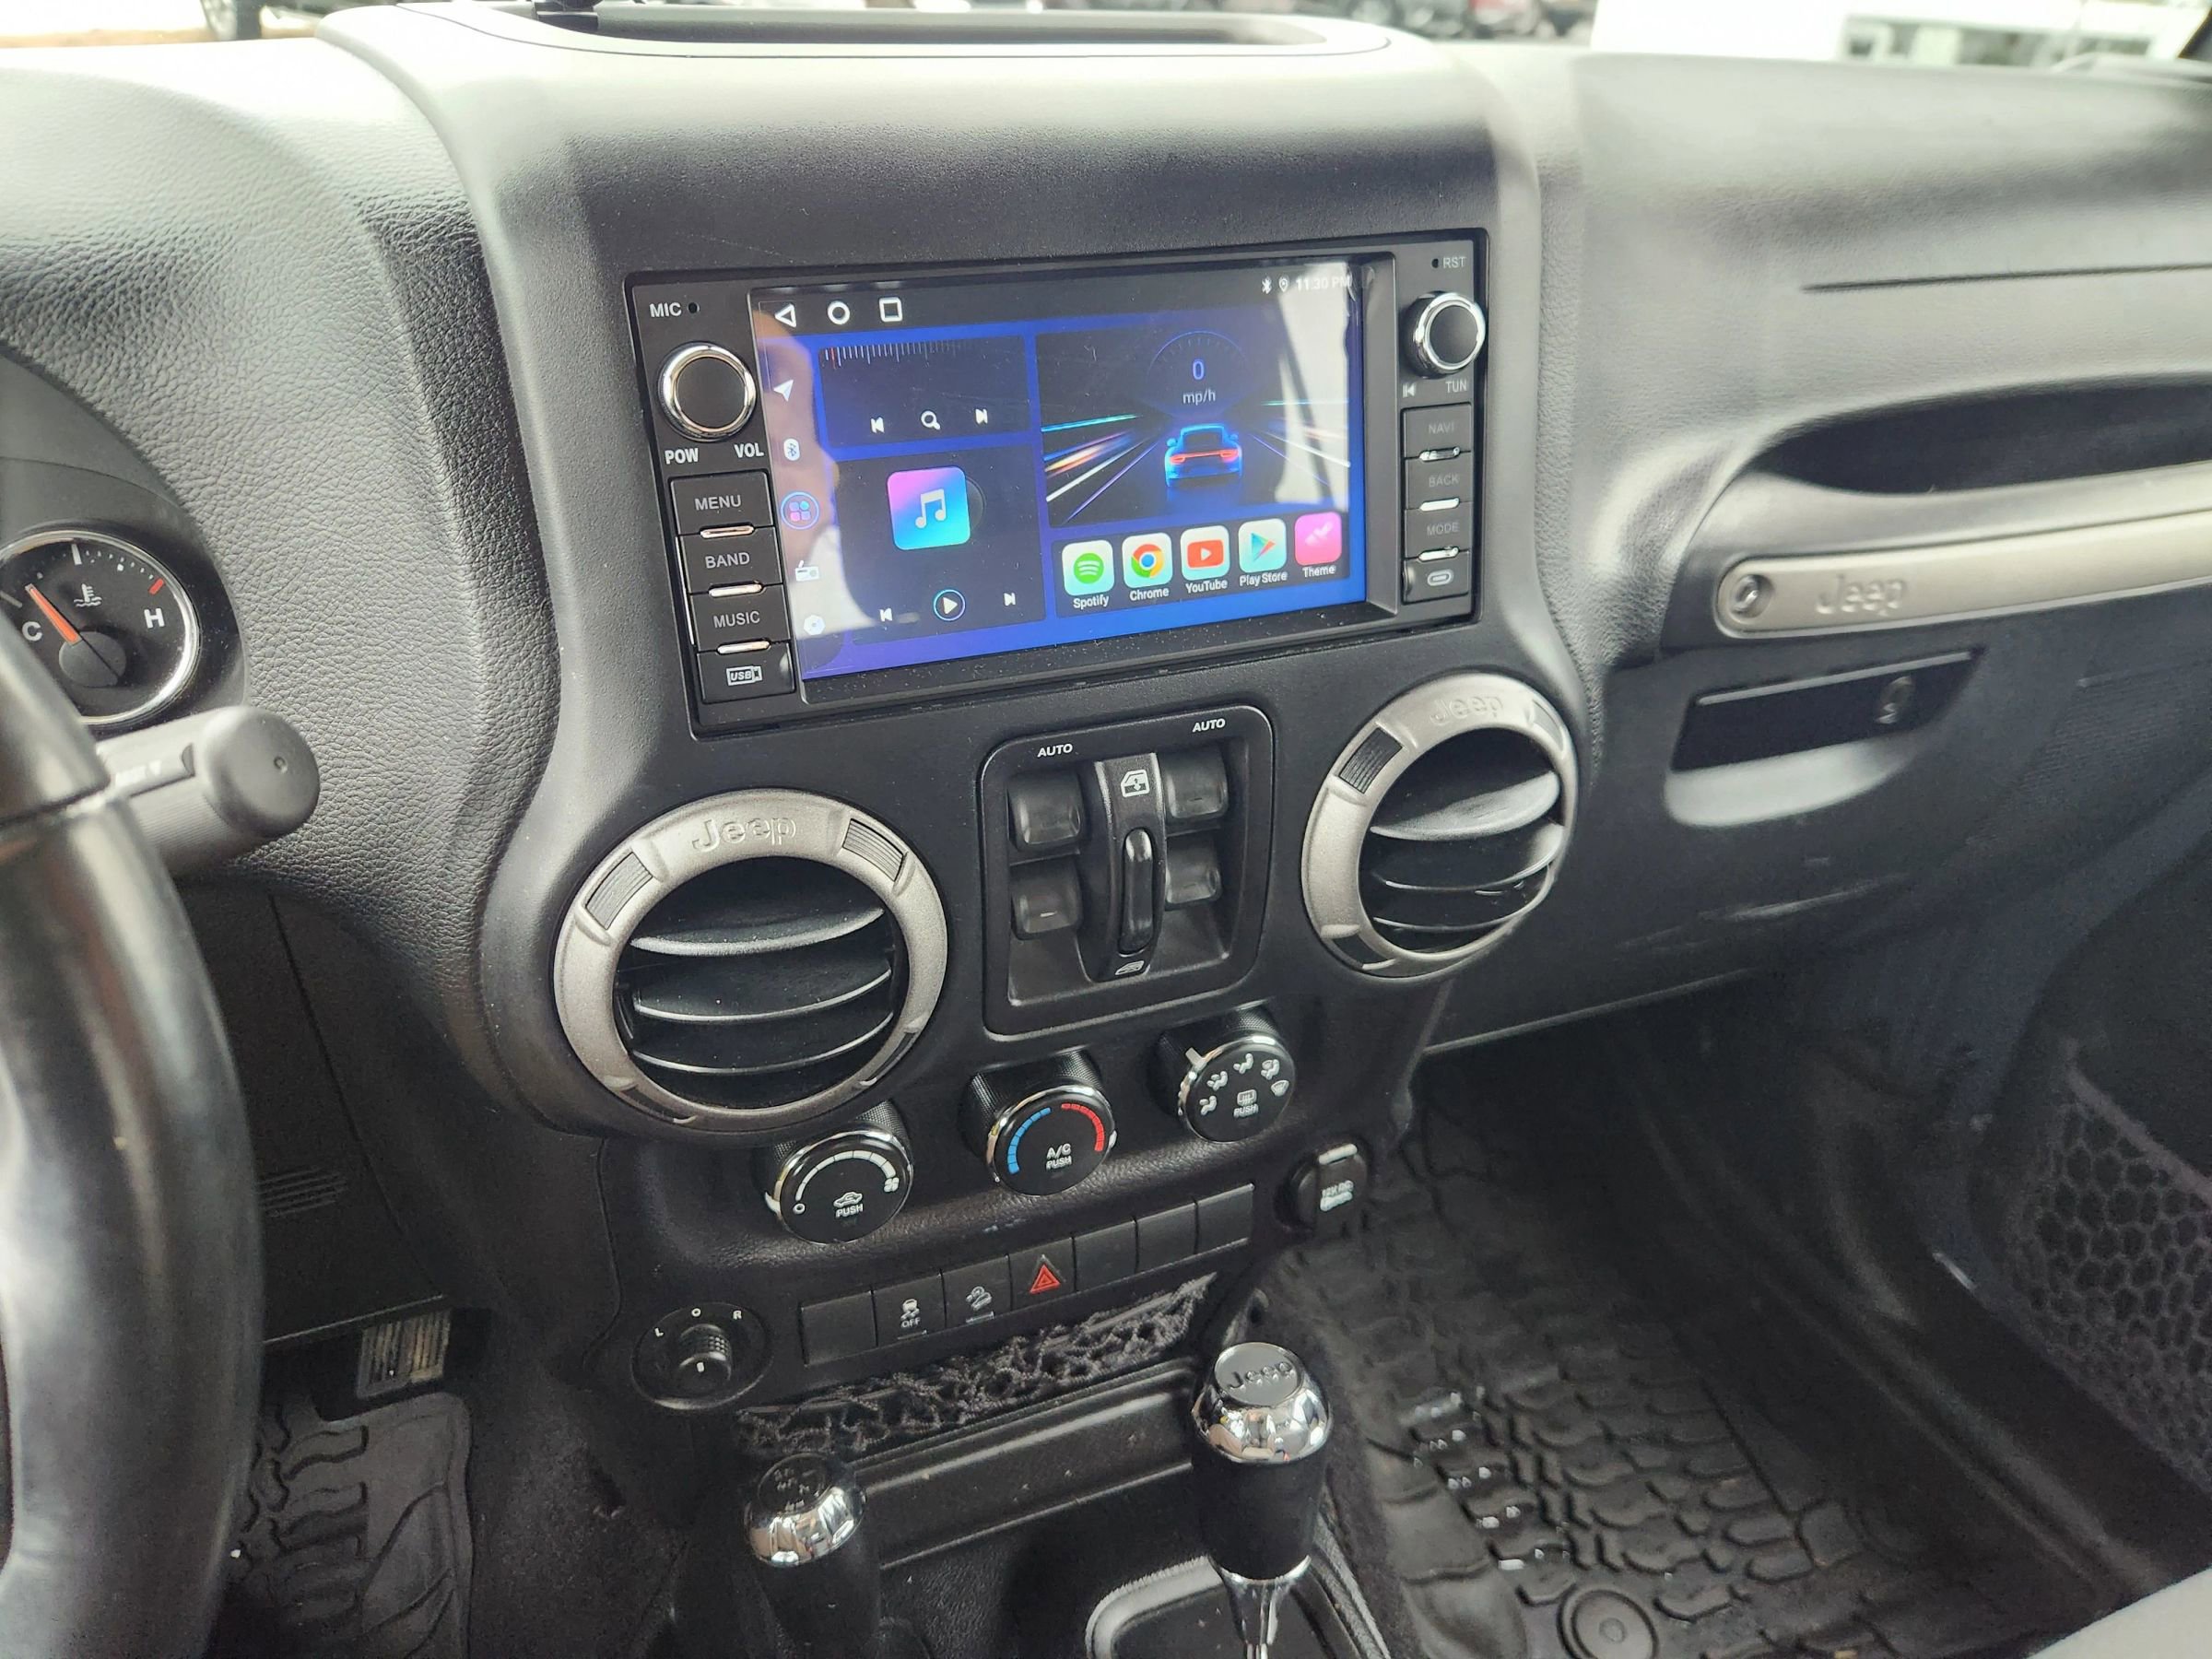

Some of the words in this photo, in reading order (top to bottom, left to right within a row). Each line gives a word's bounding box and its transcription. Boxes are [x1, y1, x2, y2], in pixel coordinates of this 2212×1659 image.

[1443, 257, 1465, 268] RST
[649, 302, 682, 318] MIC
[1192, 359, 1205, 381] 0
[1445, 380, 1468, 394] TUN
[1182, 388, 1217, 406] mp/h
[1428, 423, 1454, 434] NAVI
[665, 448, 699, 465] POW
[734, 443, 764, 459] VOL
[1428, 473, 1460, 488] BACK
[694, 495, 742, 512] MENU
[1427, 523, 1460, 536] MODE
[705, 552, 750, 570] BAND
[1239, 573, 1260, 587] Play
[1262, 571, 1288, 583] Store
[1302, 565, 1335, 578] Theme
[1129, 587, 1169, 601] Chrome
[1185, 579, 1228, 594] YouTube
[1073, 594, 1110, 609] Spotify
[1816, 574, 1907, 617] Jeep
[144, 607, 165, 629] H
[712, 611, 760, 629] MUSIC
[21, 620, 42, 641] C
[729, 671, 753, 681] USB
[1430, 696, 1504, 725] Jeep
[1193, 718, 1226, 733] AUTO
[1037, 743, 1073, 758] AUTO
[691, 816, 797, 853] Jeep
[1233, 1103, 1259, 1118] PUSH
[1046, 1143, 1072, 1159] A/C
[1046, 1155, 1073, 1171] PUSH
[835, 1204, 864, 1218] PUSH
[733, 1310, 742, 1320] R
[901, 1317, 921, 1328] OFF
[654, 1327, 664, 1337] L
